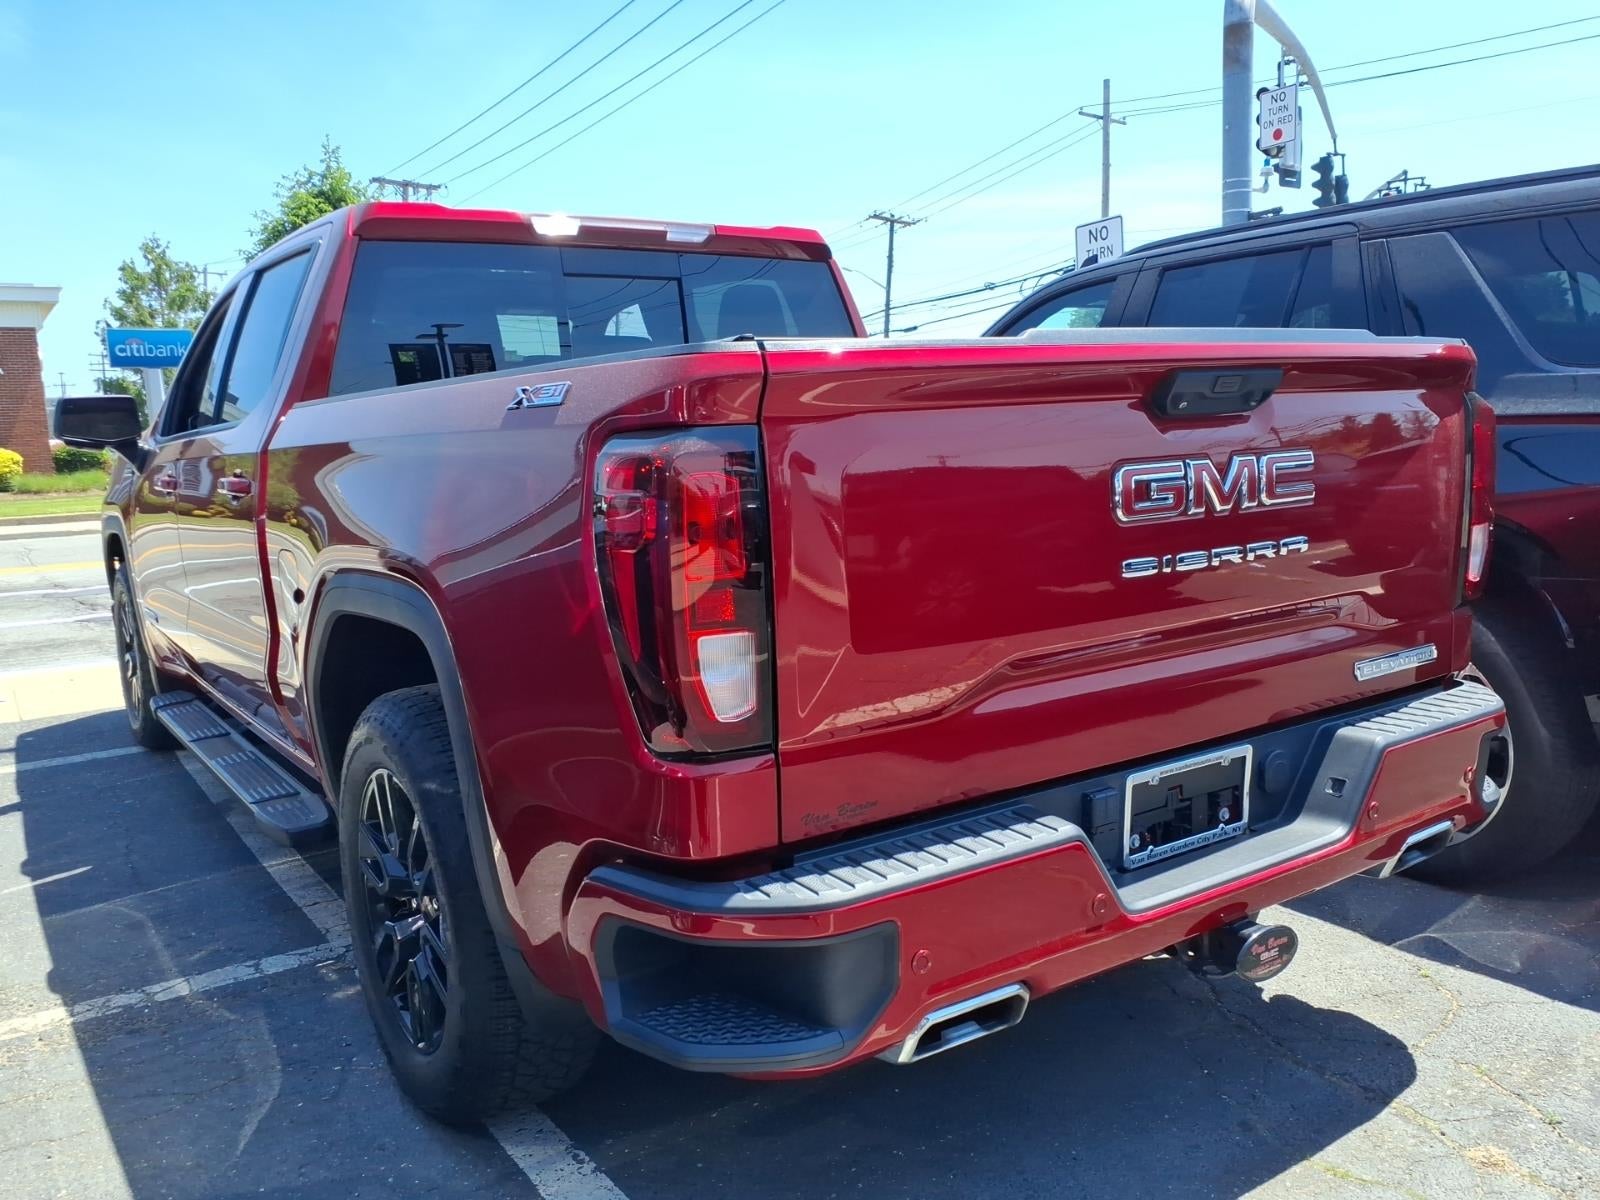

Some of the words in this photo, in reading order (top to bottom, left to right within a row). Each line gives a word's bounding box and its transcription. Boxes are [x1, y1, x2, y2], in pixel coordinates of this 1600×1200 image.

[1270, 91, 1287, 104] NO
[1268, 104, 1289, 117] TURN
[1263, 119, 1275, 130] ON
[1277, 114, 1293, 126] RED
[1088, 225, 1109, 244] NO
[114, 340, 187, 357] citibank
[1111, 449, 1316, 523] GMC
[1121, 535, 1310, 579] SIERRA
[1362, 648, 1433, 675] ELEVATION
[1130, 856, 1145, 865] Van
[1147, 849, 1169, 861] Buren
[1169, 840, 1196, 854] Garden
[1197, 837, 1211, 846] City
[1232, 825, 1242, 833] NY
